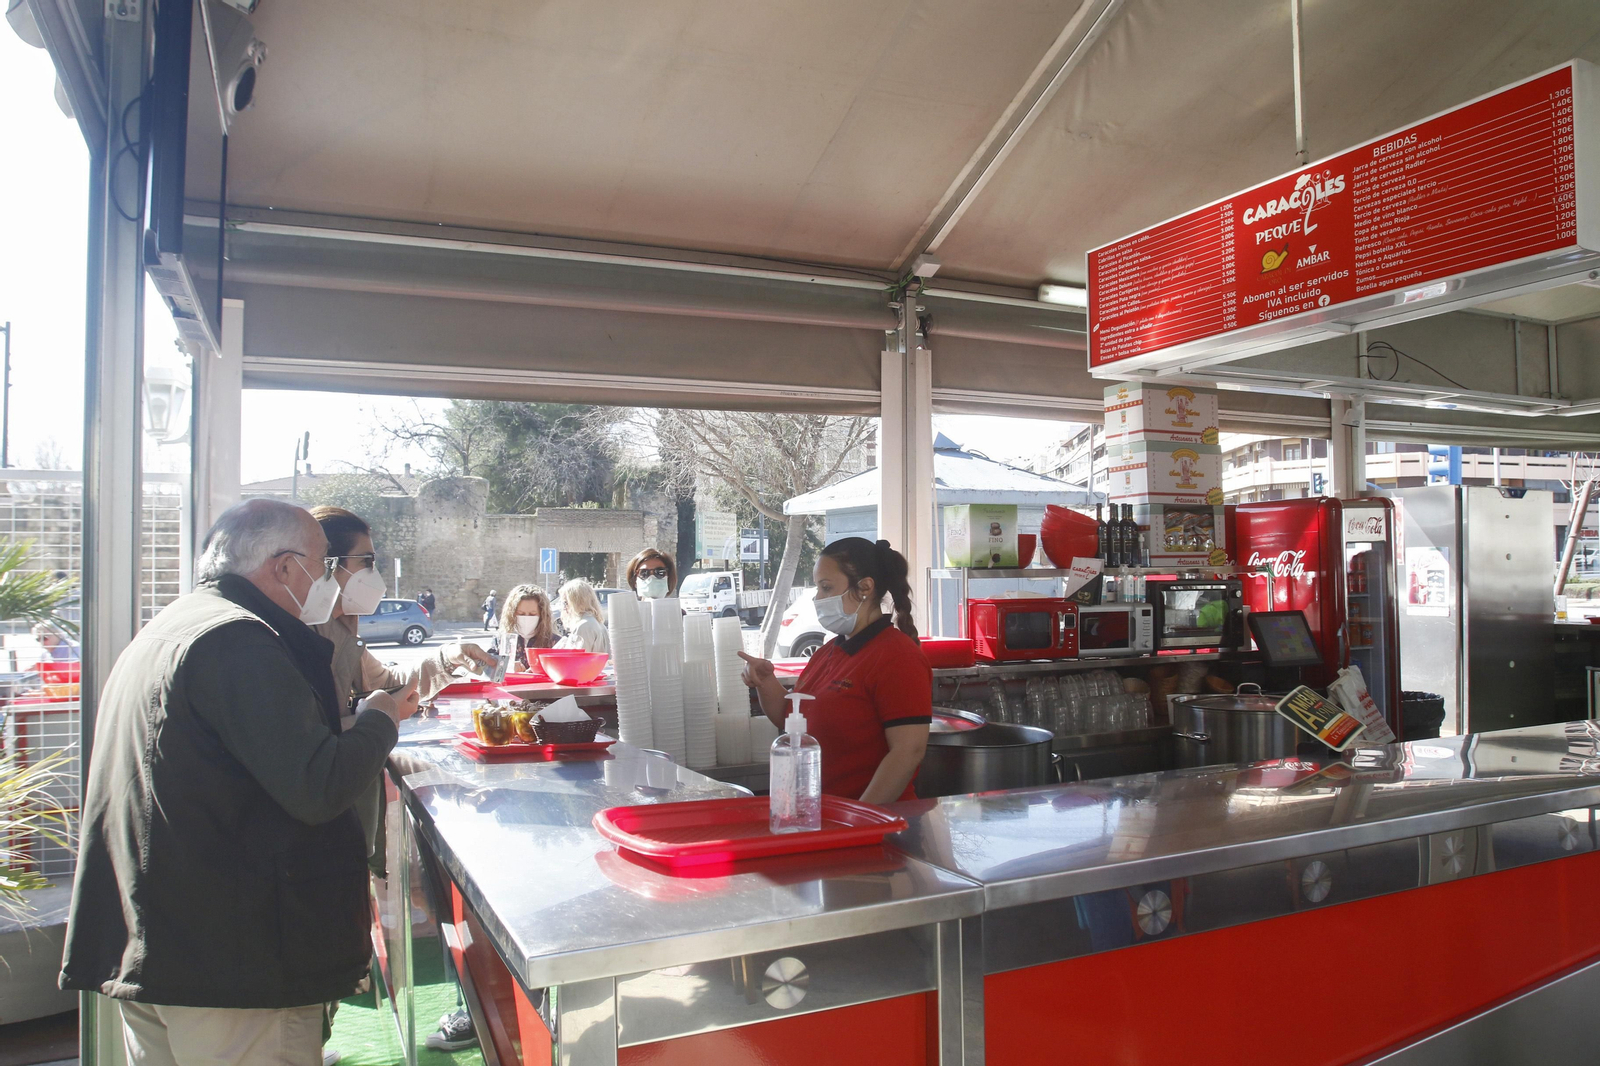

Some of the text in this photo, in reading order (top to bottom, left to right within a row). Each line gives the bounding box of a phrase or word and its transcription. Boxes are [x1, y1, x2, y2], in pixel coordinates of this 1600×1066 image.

[1353, 164, 1368, 173] Jarra
[1379, 151, 1403, 163] cerveza
[1405, 146, 1416, 154] con
[1418, 135, 1442, 149] alcohol
[1550, 87, 1571, 100] 1.30€
[1353, 172, 1369, 181] Jarra
[1379, 159, 1403, 171] cerveza
[1416, 145, 1440, 158] alcohol
[1552, 97, 1572, 109] 1.40€
[1374, 133, 1417, 157] BEBIDAS
[1353, 180, 1369, 189] Jarra
[1379, 168, 1403, 179] cerveza
[1405, 159, 1426, 170] Radler
[1552, 106, 1572, 118] 1.40€
[1353, 187, 1371, 196] Tercio
[1381, 175, 1405, 187] cerveza
[1552, 115, 1572, 127] 1.50€
[1353, 195, 1371, 204] Tercio
[1382, 183, 1406, 195] cerveza
[1407, 178, 1417, 186] 0,0
[1553, 125, 1572, 137] 1.70€
[1354, 134, 1573, 212] Cervezas especiales tercio 1.80€
[1354, 211, 1372, 220] Tercio
[1382, 200, 1406, 211] cerveza
[1553, 144, 1573, 155] 1.70€
[1354, 219, 1372, 228] Medio
[1397, 205, 1418, 215] blanco
[1554, 153, 1573, 165] 1.20€
[1354, 228, 1369, 236] Copa
[1554, 163, 1574, 174] 1.70€
[1354, 236, 1369, 244] Tinto
[1380, 227, 1401, 236] verano
[1554, 172, 1574, 183] 1.50€
[1355, 182, 1574, 252] Refresco 1.20€
[1098, 248, 1117, 257] Caracoles
[1118, 242, 1131, 250] Chicos
[1220, 203, 1232, 211] 1.20€
[1355, 252, 1371, 260] Pepsi
[1373, 245, 1393, 255] botella
[1552, 192, 1574, 203] 1.60€
[1356, 259, 1376, 268] Nestea
[1383, 249, 1412, 260] Aquarius
[1554, 201, 1575, 212] 1.30€
[1356, 267, 1374, 275] Tónica
[1381, 259, 1403, 269] Casera
[1554, 210, 1575, 221] 1.20€
[1098, 255, 1115, 264] Cabrillas
[1098, 261, 1117, 270] Caracoles
[1123, 252, 1141, 261] Picantón
[1099, 267, 1118, 276] Caracoles
[1118, 262, 1133, 270] Gordos
[1297, 251, 1330, 268] AMBAR
[1356, 220, 1576, 284] Zumos 1.20€
[1356, 283, 1377, 292] Botella
[1395, 271, 1422, 283] pequeña
[1555, 229, 1576, 240] 1.00€
[1099, 274, 1118, 283] Caracoles
[1119, 266, 1140, 276] Carbonara
[1099, 280, 1118, 289] Caracoles
[1119, 273, 1140, 282] Mexicanos
[1099, 287, 1118, 296] Caracoles
[1243, 270, 1349, 304] Abonen al ser servidos
[1099, 293, 1118, 302] Caracoles
[1119, 287, 1139, 296] Cortijeros
[1099, 300, 1118, 309] Caracoles
[1099, 307, 1119, 315] Caracoles
[1259, 301, 1314, 321] Síguenos en
[1268, 288, 1321, 308] IVA incluido
[1100, 313, 1119, 321] Caracoles
[1124, 306, 1139, 314] Pelotón
[1111, 321, 1136, 331] Degustación
[1100, 332, 1124, 341] Ingredientes
[1346, 517, 1384, 536] Coca-Cola
[588, 540, 592, 548] 2
[1287, 688, 1326, 731] AMBAR
